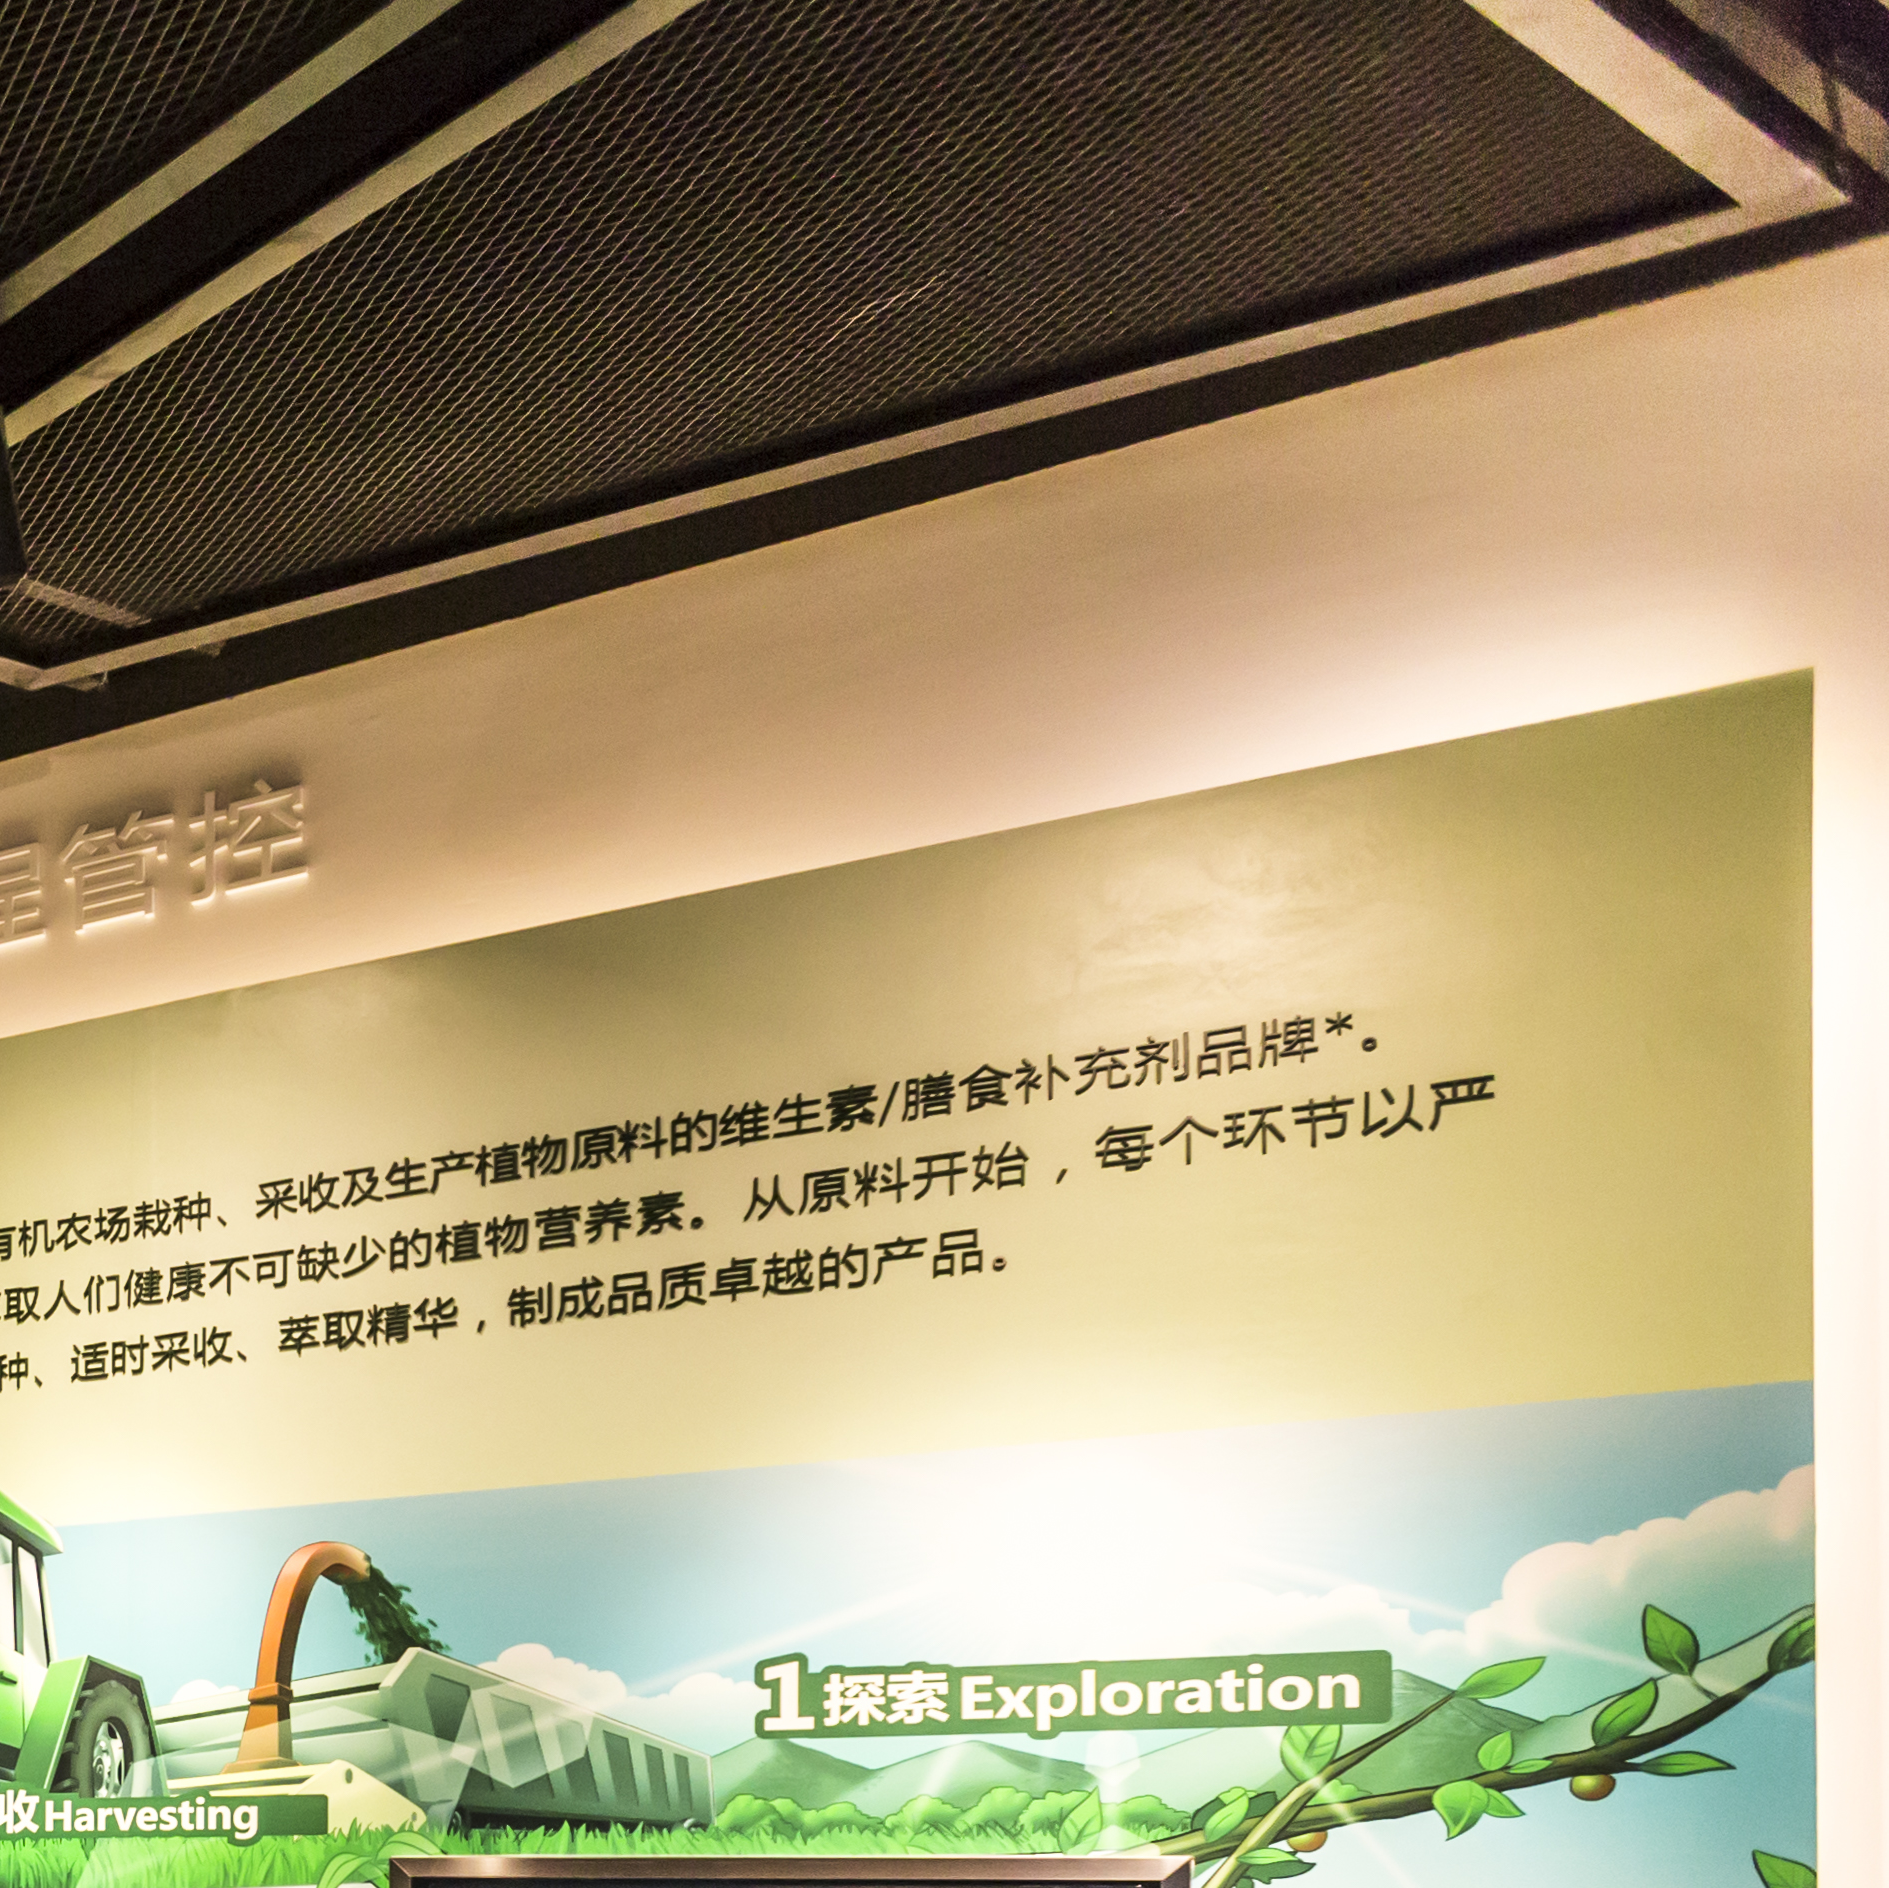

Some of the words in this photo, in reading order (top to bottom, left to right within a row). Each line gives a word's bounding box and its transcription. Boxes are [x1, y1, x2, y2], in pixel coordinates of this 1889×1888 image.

[823, 1669, 950, 1727] 探索
[960, 1663, 1361, 1731] Exploration
[45, 1797, 259, 1839] Harvesting
